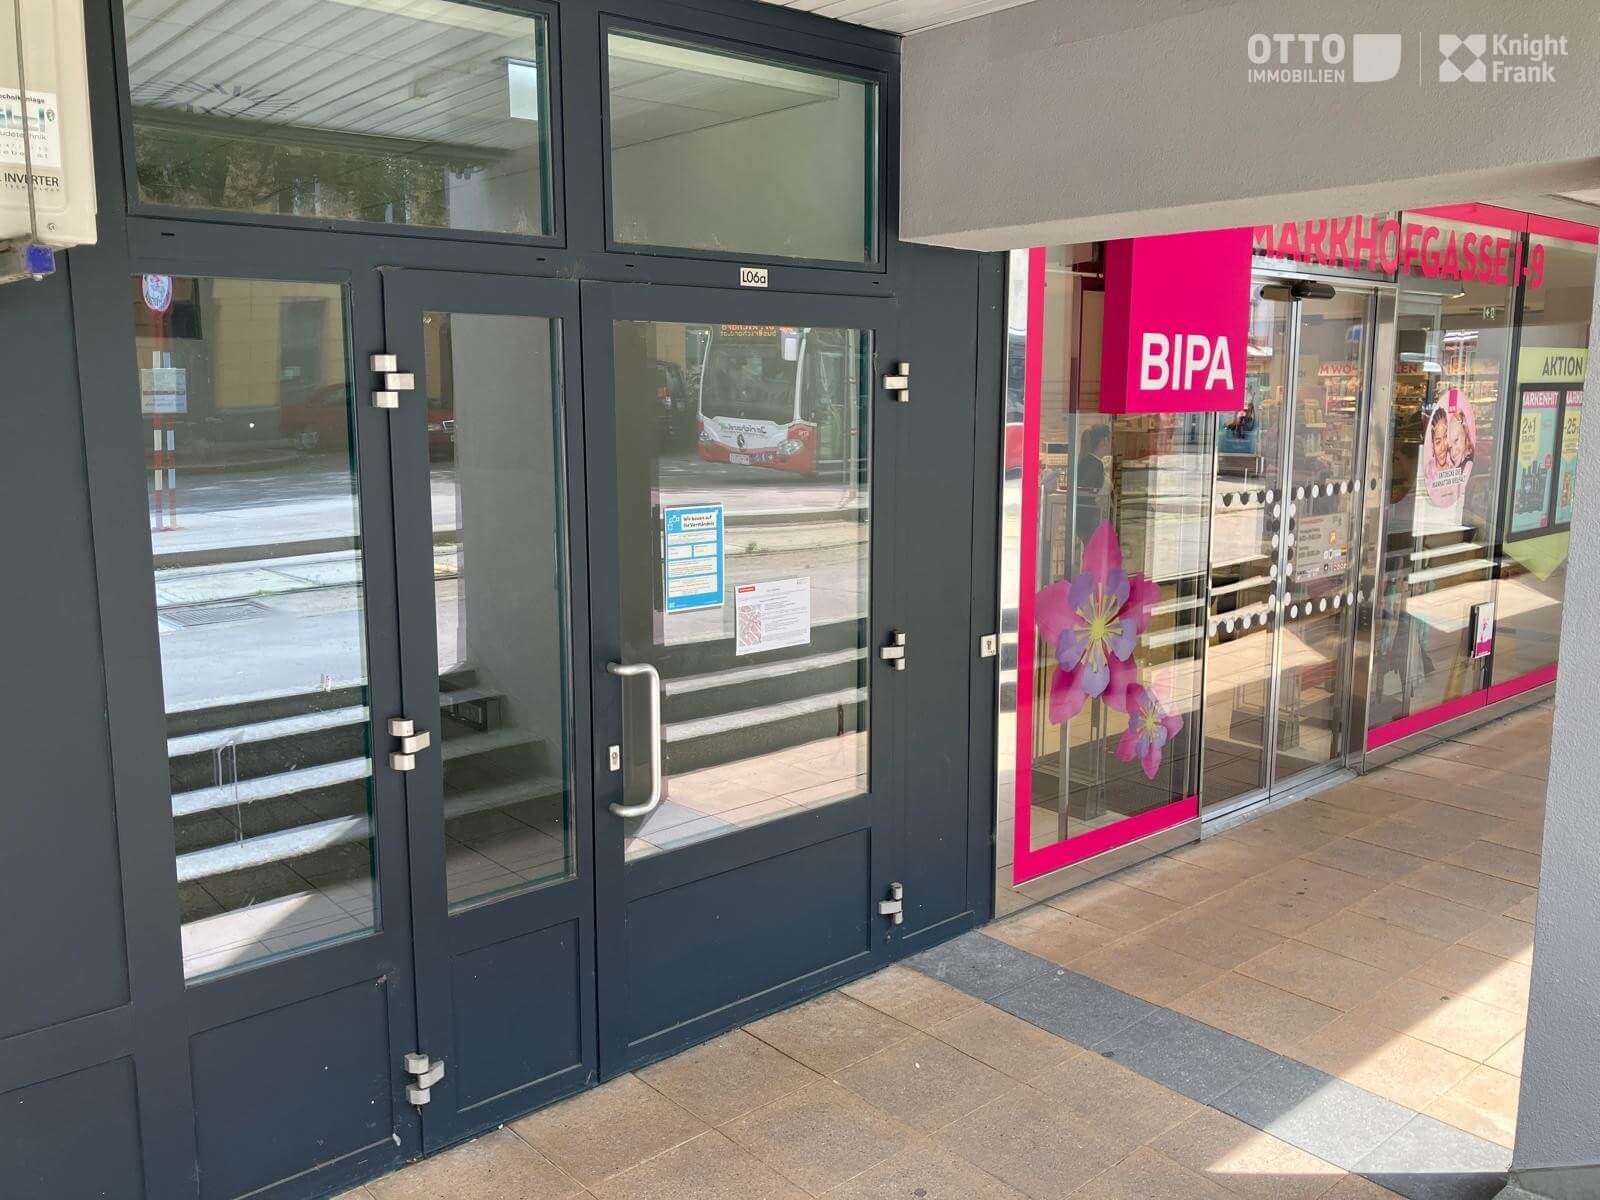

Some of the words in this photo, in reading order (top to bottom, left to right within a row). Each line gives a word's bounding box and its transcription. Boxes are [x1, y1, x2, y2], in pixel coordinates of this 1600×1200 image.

[4, 172, 59, 187] INVRTER
[1253, 214, 1511, 286] MARKHOFGASSE
[1140, 332, 1235, 391] BIPA
[1542, 356, 1584, 377] AKTION
